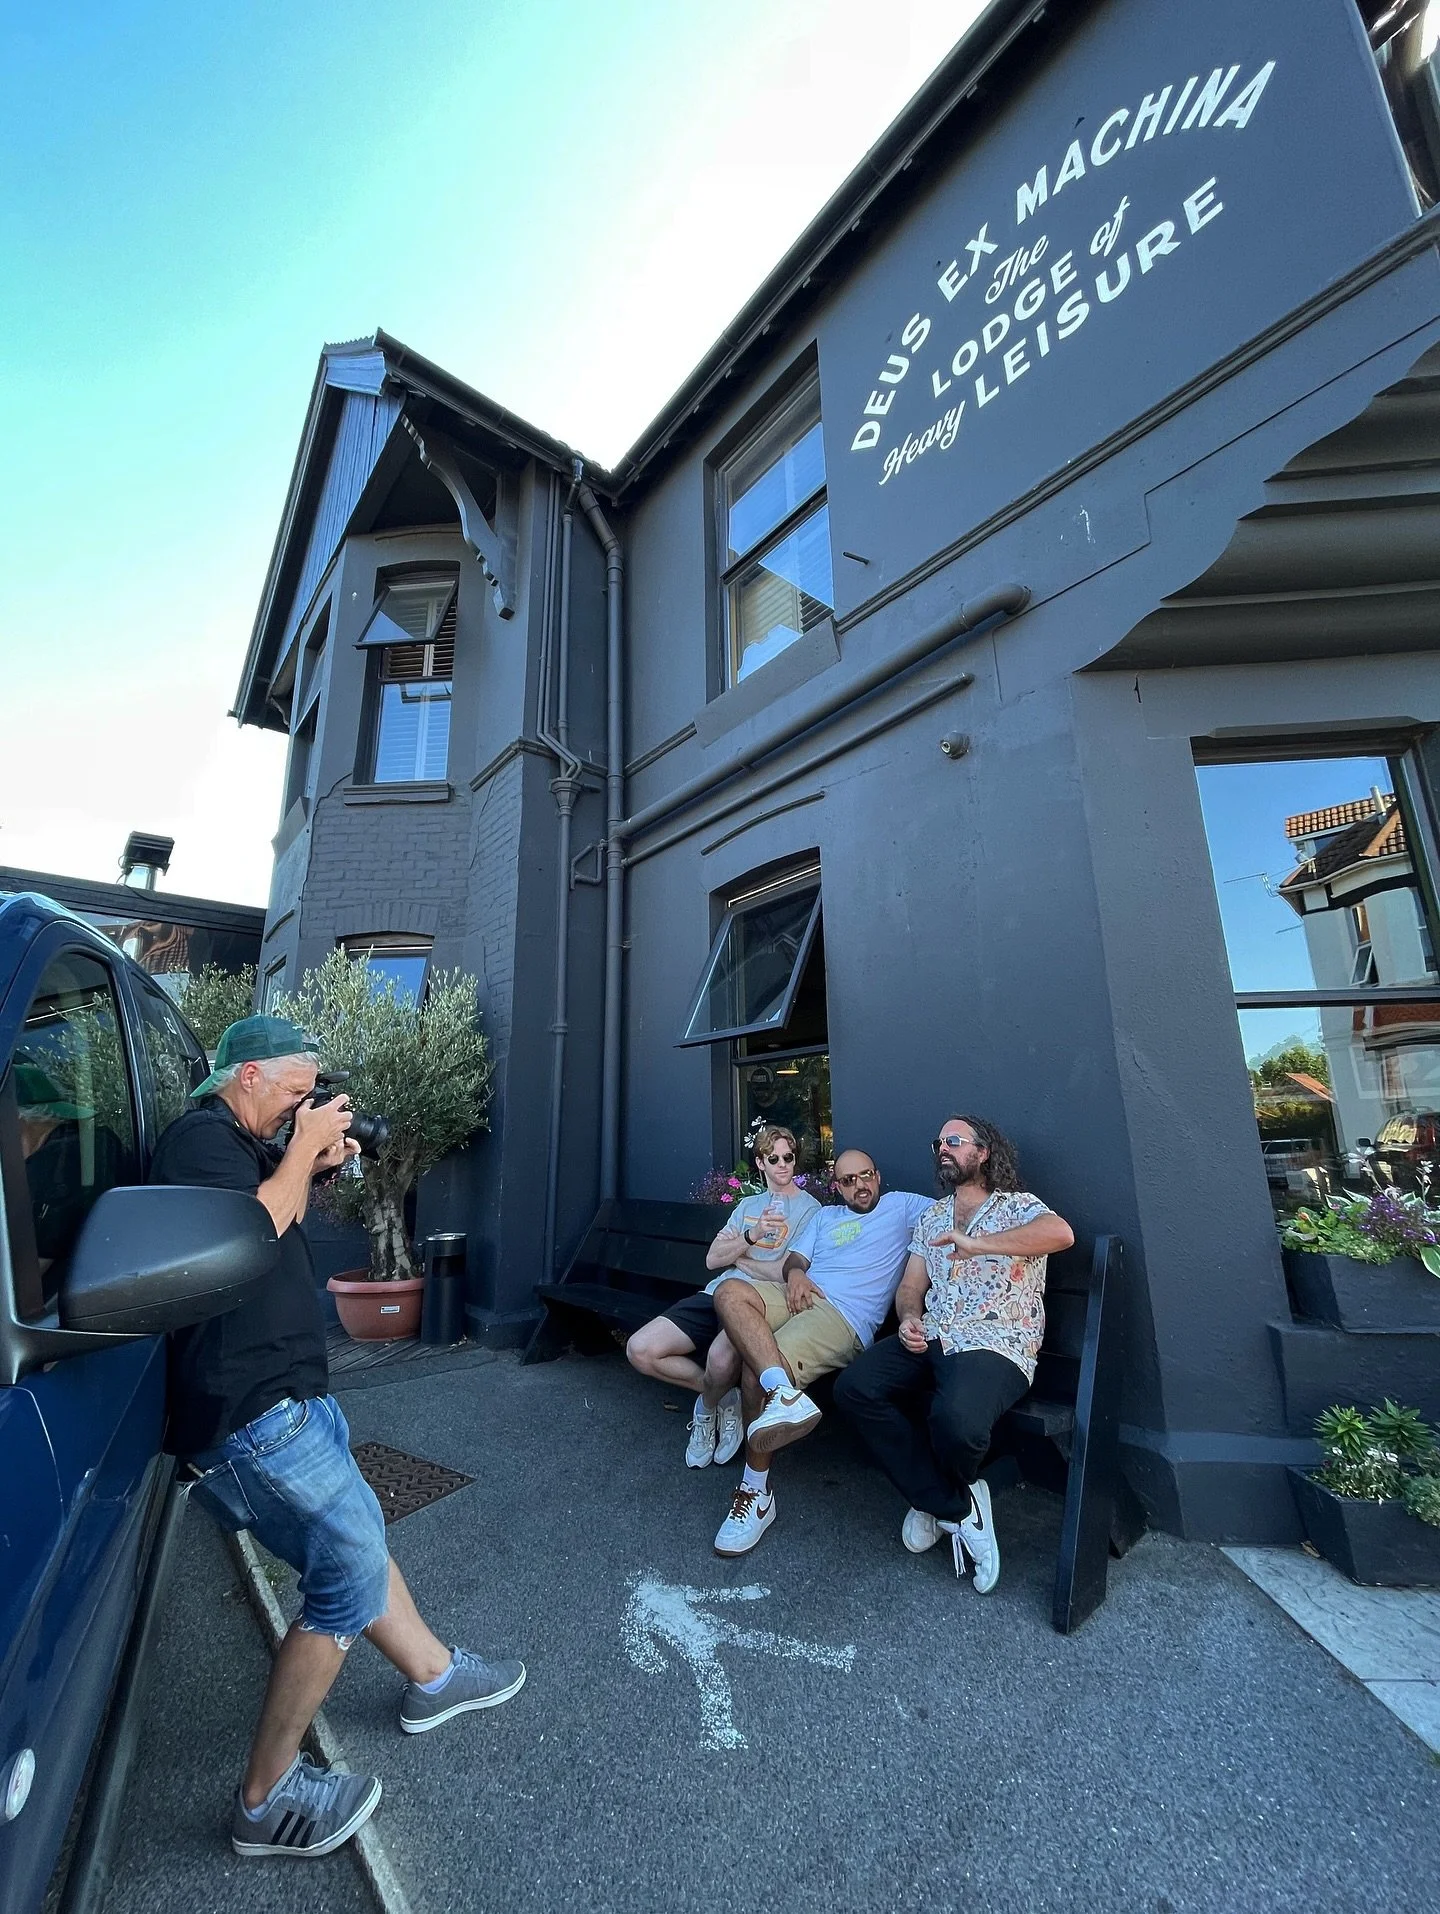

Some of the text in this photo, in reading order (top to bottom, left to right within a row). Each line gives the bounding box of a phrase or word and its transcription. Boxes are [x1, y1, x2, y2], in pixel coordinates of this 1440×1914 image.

[850, 61, 1276, 451] DEUS EX MACHINA
[879, 176, 1225, 486] Heavy LEISURE
[931, 195, 1131, 398] LODGE of
[984, 234, 1049, 305] The
[725, 1419, 737, 1432] N
